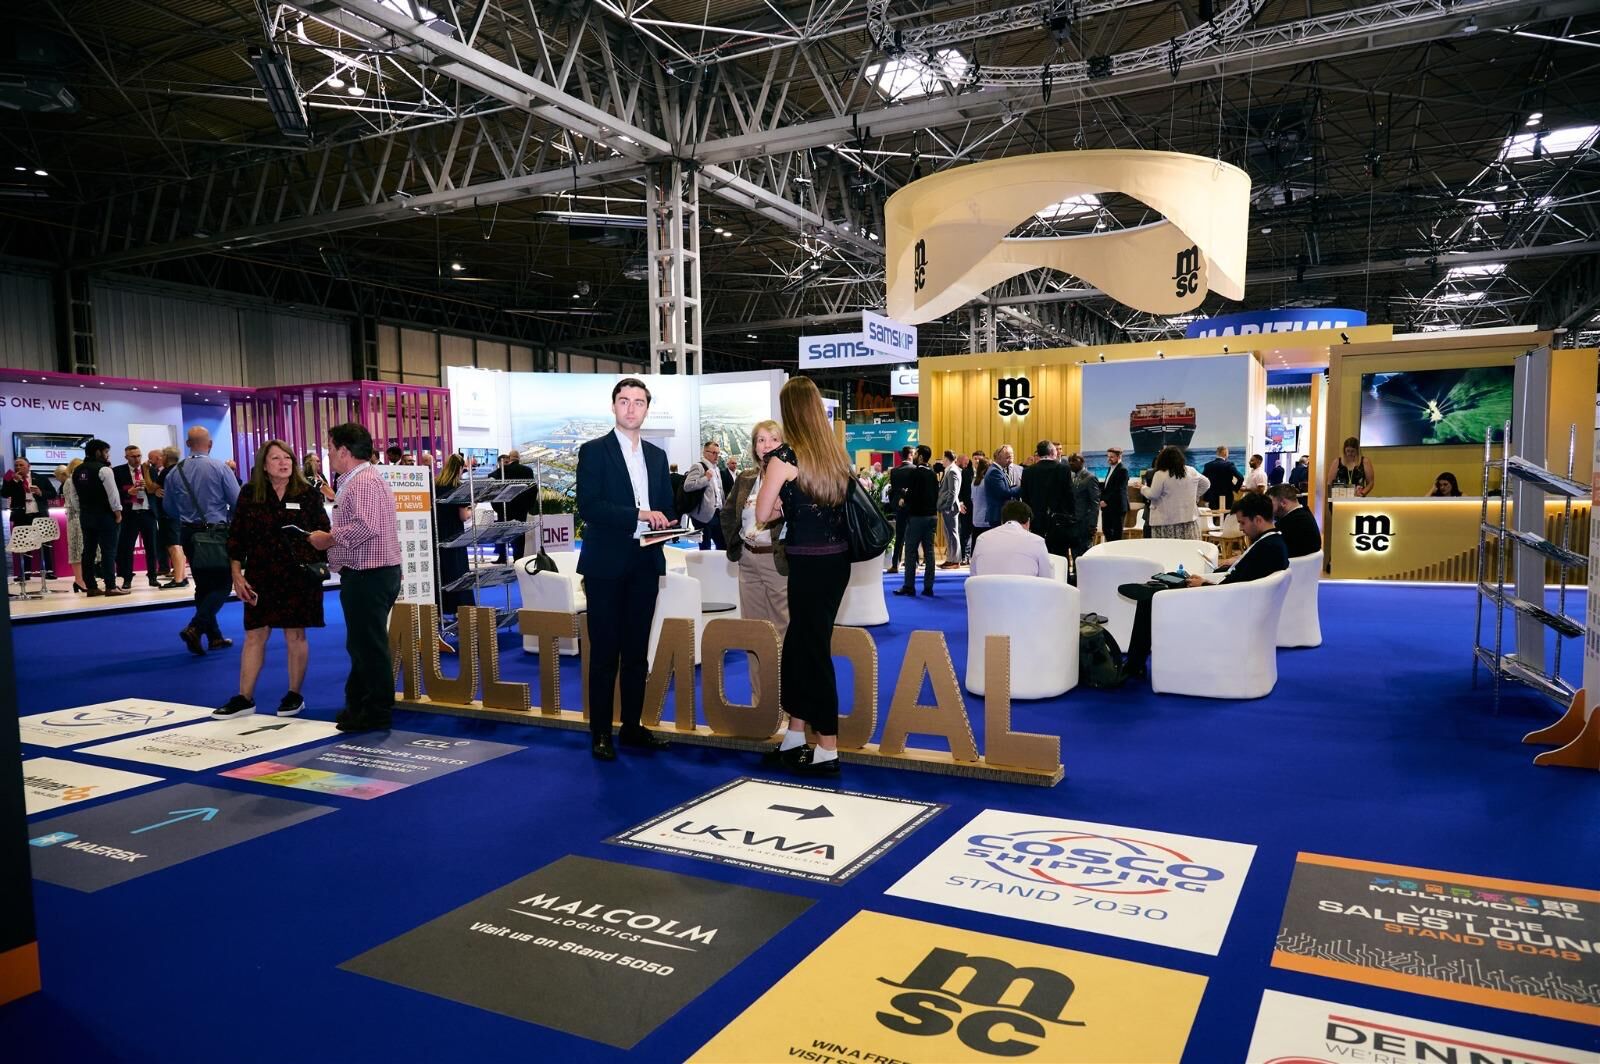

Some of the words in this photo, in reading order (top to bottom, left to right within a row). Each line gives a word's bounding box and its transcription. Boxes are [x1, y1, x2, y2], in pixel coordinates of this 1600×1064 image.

[11, 397, 45, 410] ONE,
[48, 399, 69, 410] WE
[73, 400, 104, 412] CAN.
[45, 450, 67, 458] ONE
[398, 494, 410, 502] FOR
[543, 527, 568, 543] ONE
[62, 840, 148, 862] MAERSK
[673, 820, 835, 860] UKWA
[964, 848, 1208, 893] SHIPPING
[966, 834, 1225, 882] COSCO
[944, 875, 1062, 902] STAND
[1072, 895, 1168, 921] 7030
[1368, 884, 1584, 921] MULTIMODAL
[518, 892, 719, 945] MALCOLM
[1318, 899, 1449, 930] SALES
[1409, 904, 1478, 922] VISIT
[1489, 916, 1544, 932] THE
[552, 917, 643, 942] LOGISTICS
[1383, 922, 1485, 947] STAND
[1496, 940, 1582, 961] 5048
[469, 921, 512, 938] Visit
[508, 930, 535, 942] us
[533, 936, 559, 949] on
[557, 940, 618, 963] Stand
[616, 955, 675, 977] 5050
[788, 1047, 834, 1064] VISIT
[812, 1040, 848, 1054] WIN
[850, 1050, 860, 1059] A
[864, 1052, 911, 1064] FRE
